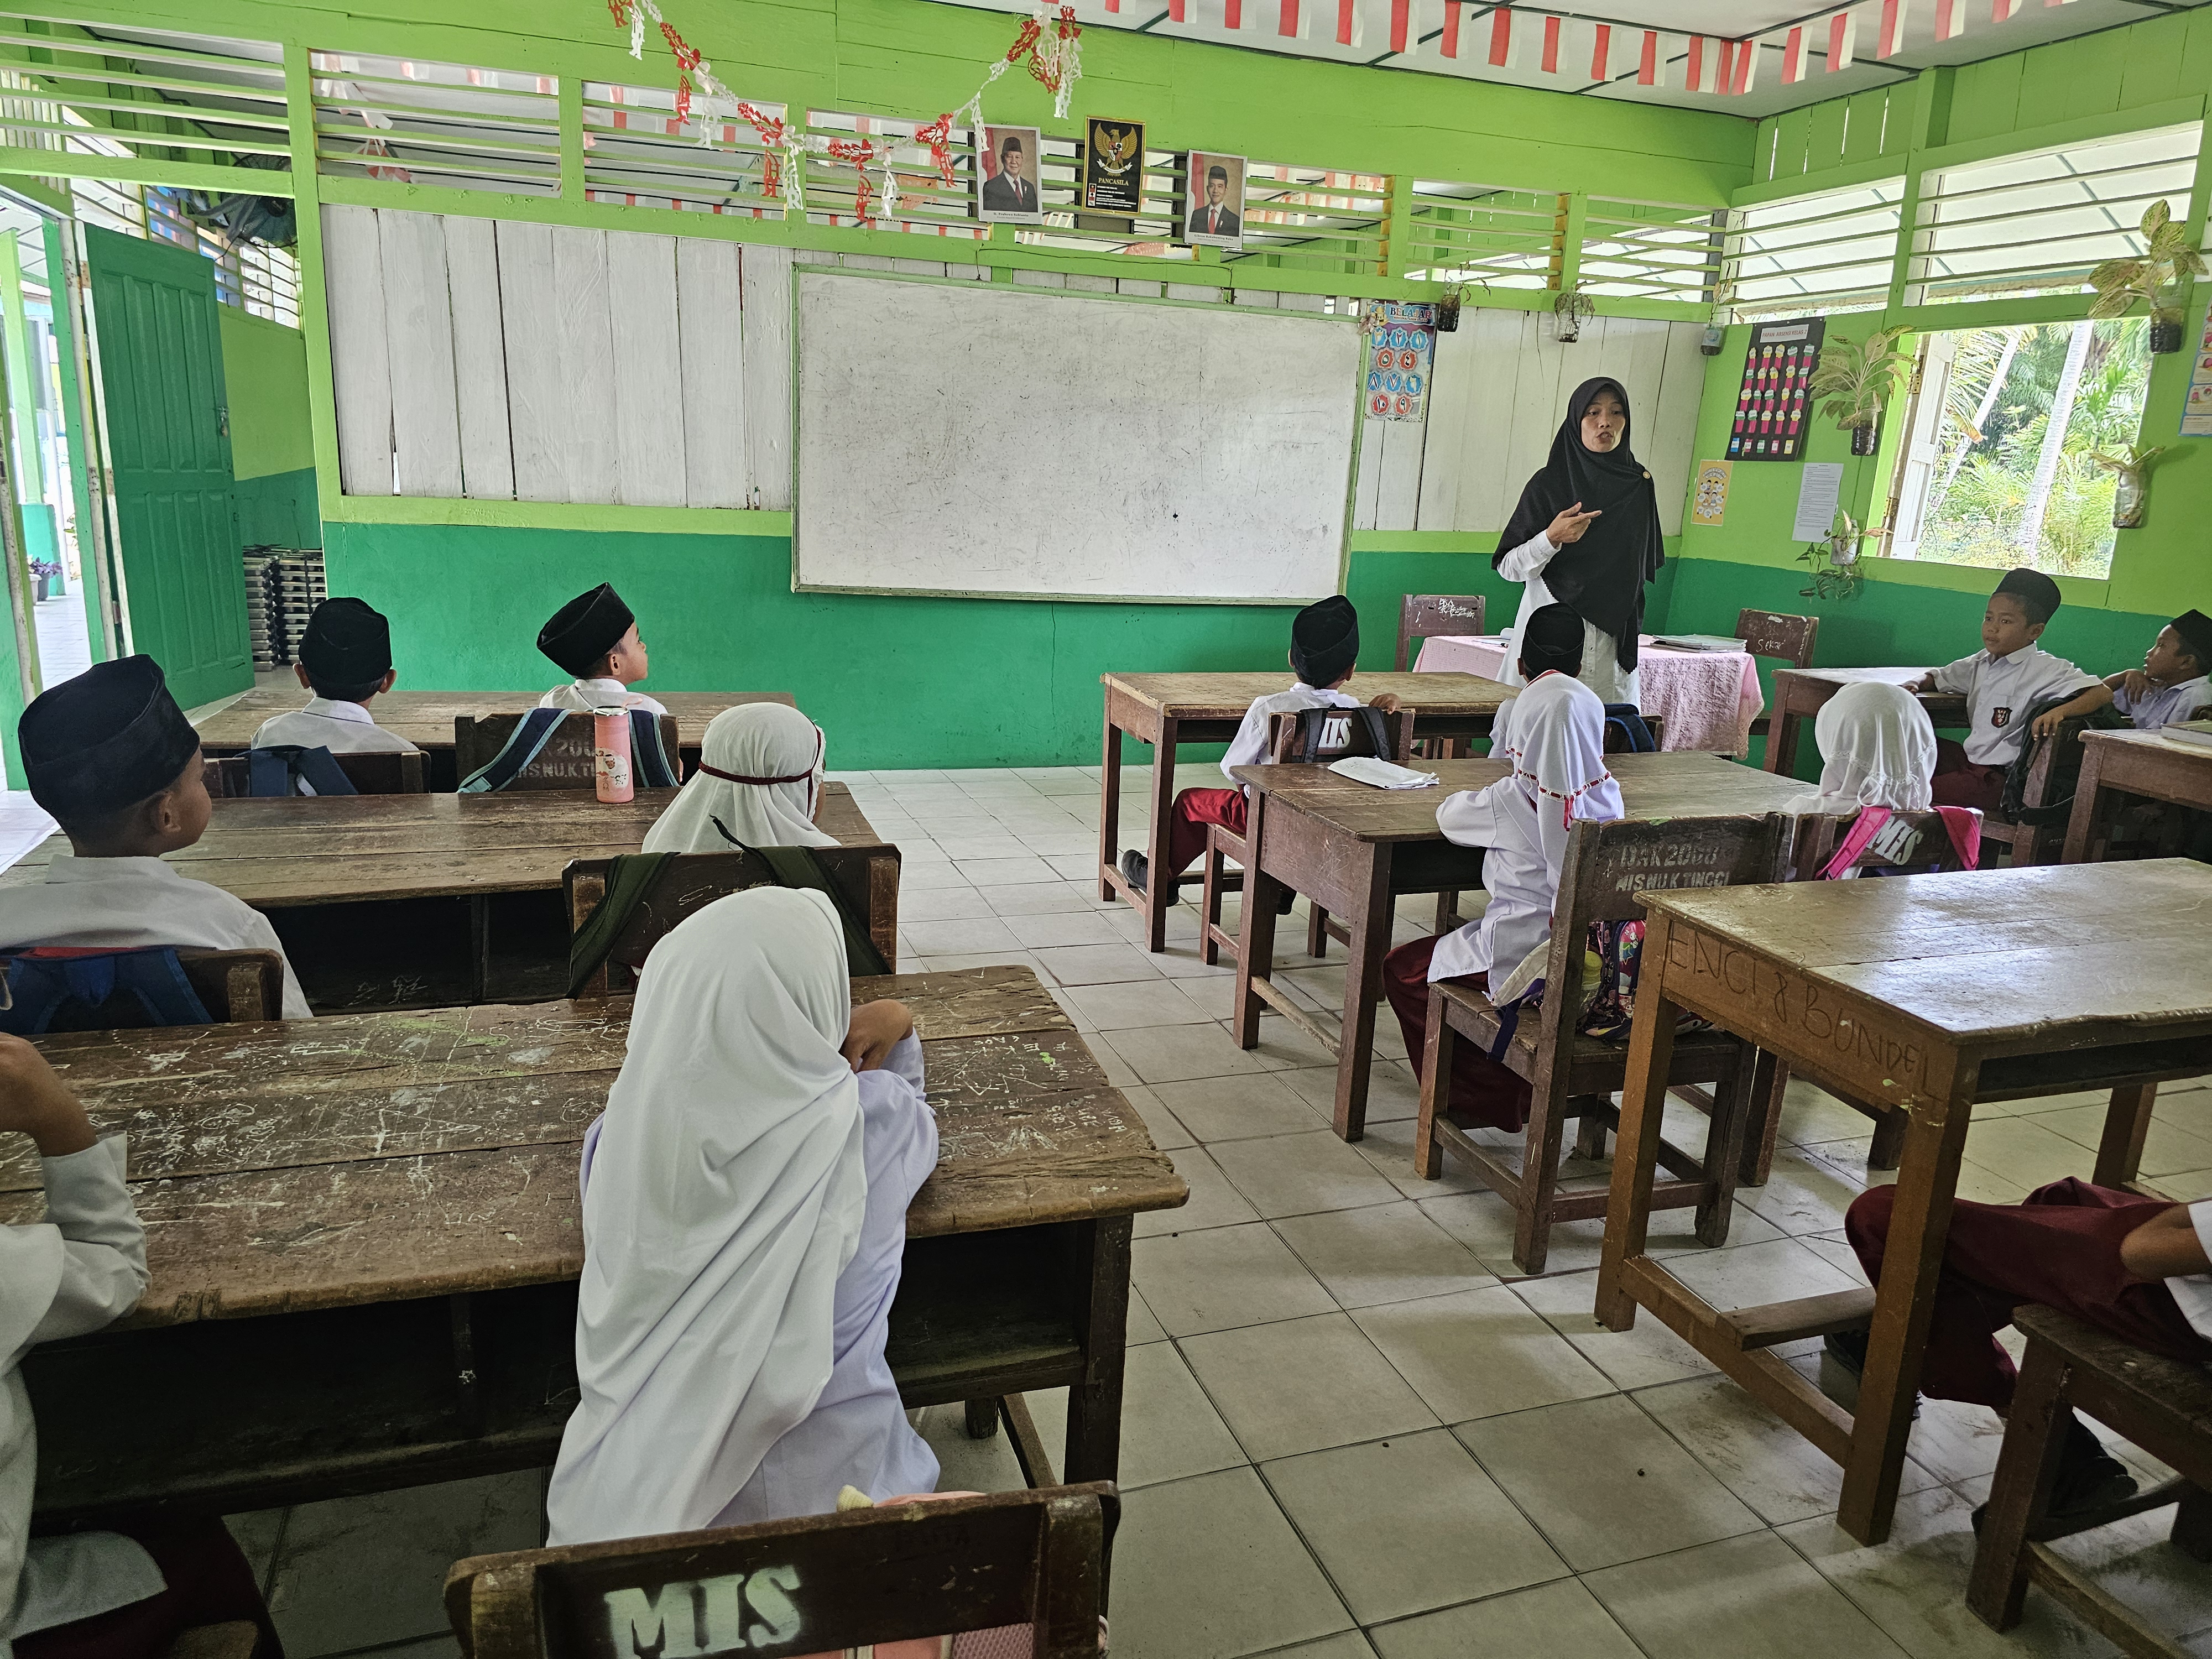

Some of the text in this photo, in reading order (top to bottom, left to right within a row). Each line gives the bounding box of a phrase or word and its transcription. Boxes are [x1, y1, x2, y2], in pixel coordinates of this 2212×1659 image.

[1098, 178, 1129, 186] PANCASILA
[1390, 307, 1432, 319] BELAJAR
[1318, 717, 1352, 748] IS
[1866, 816, 1923, 865] MIS
[603, 1564, 801, 1659] MIS
